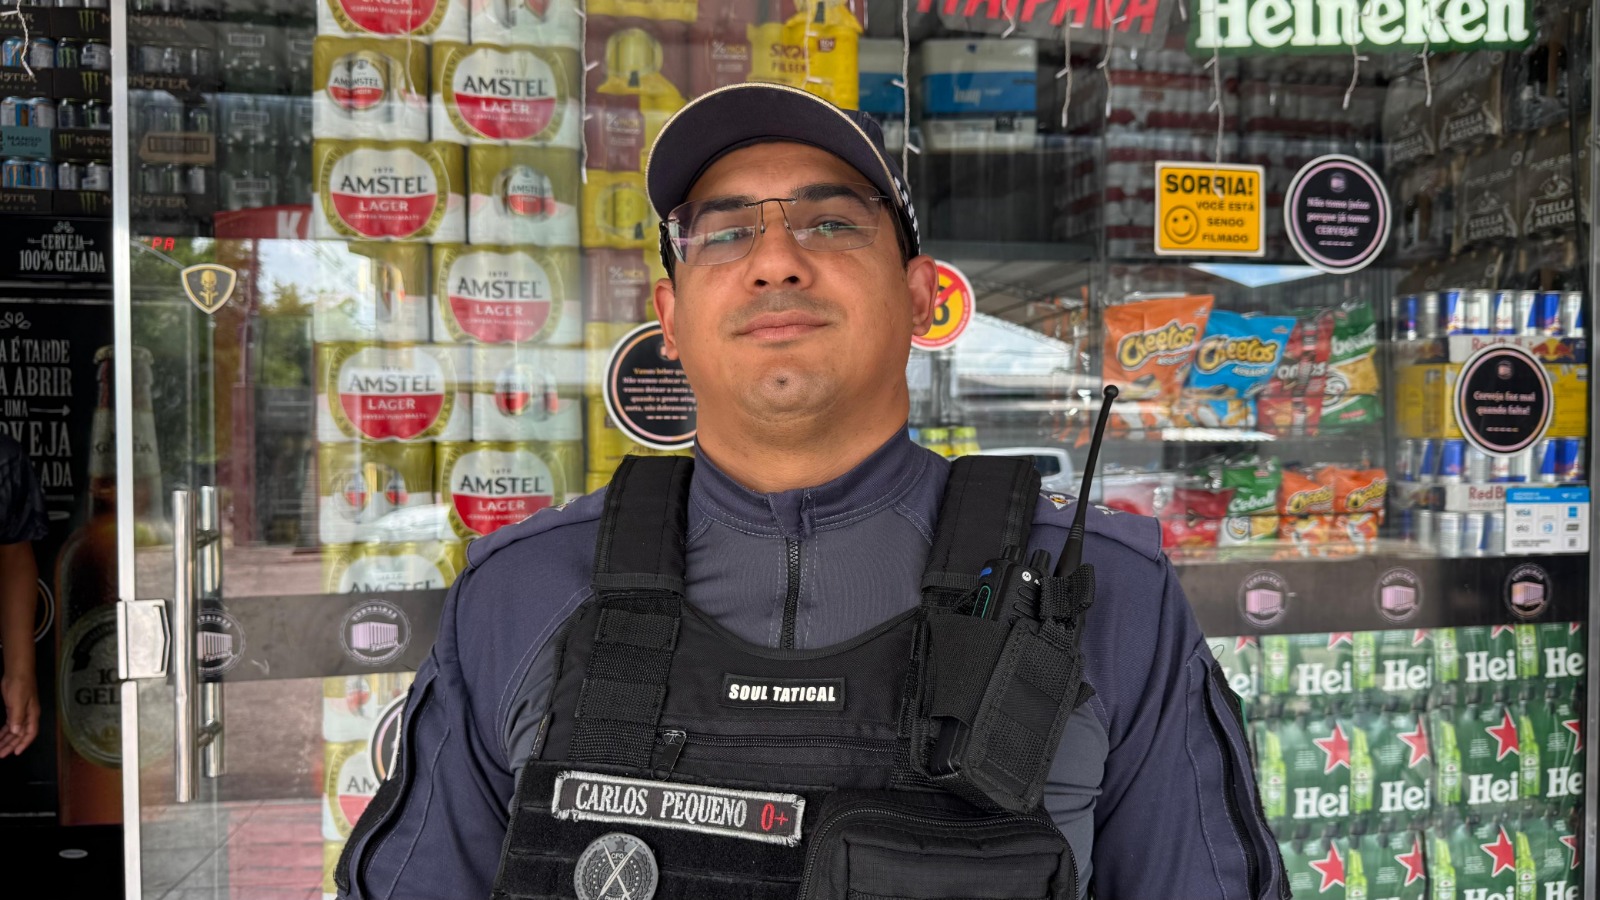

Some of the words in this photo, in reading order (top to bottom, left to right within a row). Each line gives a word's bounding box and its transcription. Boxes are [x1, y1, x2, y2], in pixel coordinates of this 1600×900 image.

[1196, 0, 1531, 48] Heineken
[463, 75, 548, 97] AMSTEL
[481, 101, 530, 115] LAGER
[340, 175, 427, 195] AMSTEL
[1166, 173, 1255, 196] SORRIA!
[359, 200, 408, 213] LAGER
[1196, 199, 1225, 211] VOCÊ
[1307, 197, 1324, 208] Não
[1325, 200, 1347, 209] tomo
[1535, 198, 1574, 215] STELLA
[1206, 217, 1244, 227] SENDO
[1307, 213, 1336, 224] porque
[1347, 214, 1371, 224] tomo
[1535, 210, 1576, 228] ARTOIS
[1202, 233, 1249, 244] FILMADO
[1315, 225, 1359, 237] CERVEJA!
[41, 234, 85, 251] CERVEJA
[20, 251, 53, 272] 100%
[55, 251, 105, 273] GELADA
[457, 277, 542, 300] AMSTEL
[475, 304, 523, 317] LAGER
[11, 336, 20, 363] É
[22, 340, 70, 364] TARDE
[1119, 322, 1196, 369] Cheetos
[1197, 338, 1278, 374] Cheetos
[13, 367, 73, 397] ABRIR
[348, 373, 436, 394] AMSTEL
[367, 398, 416, 411] LAGER
[1473, 391, 1504, 403] Cerveja
[1505, 391, 1518, 401] faz
[1519, 391, 1536, 402] mal
[4, 399, 29, 418] UMA
[1475, 406, 1507, 416] quando
[1507, 405, 1531, 416] falta!
[460, 475, 545, 495] AMSTEL
[1468, 486, 1492, 500] Red
[477, 500, 526, 511] LAGER
[1383, 658, 1433, 692] Hei
[1465, 649, 1517, 683] Hei
[1296, 661, 1353, 696] Hei
[728, 683, 767, 701] SOUL
[773, 685, 836, 703] TATICAL
[1380, 780, 1430, 813] Hei
[1468, 772, 1518, 805] Hei
[575, 781, 649, 817] CARLOS
[660, 790, 747, 828] PEQUENO
[1293, 785, 1349, 819] Hei
